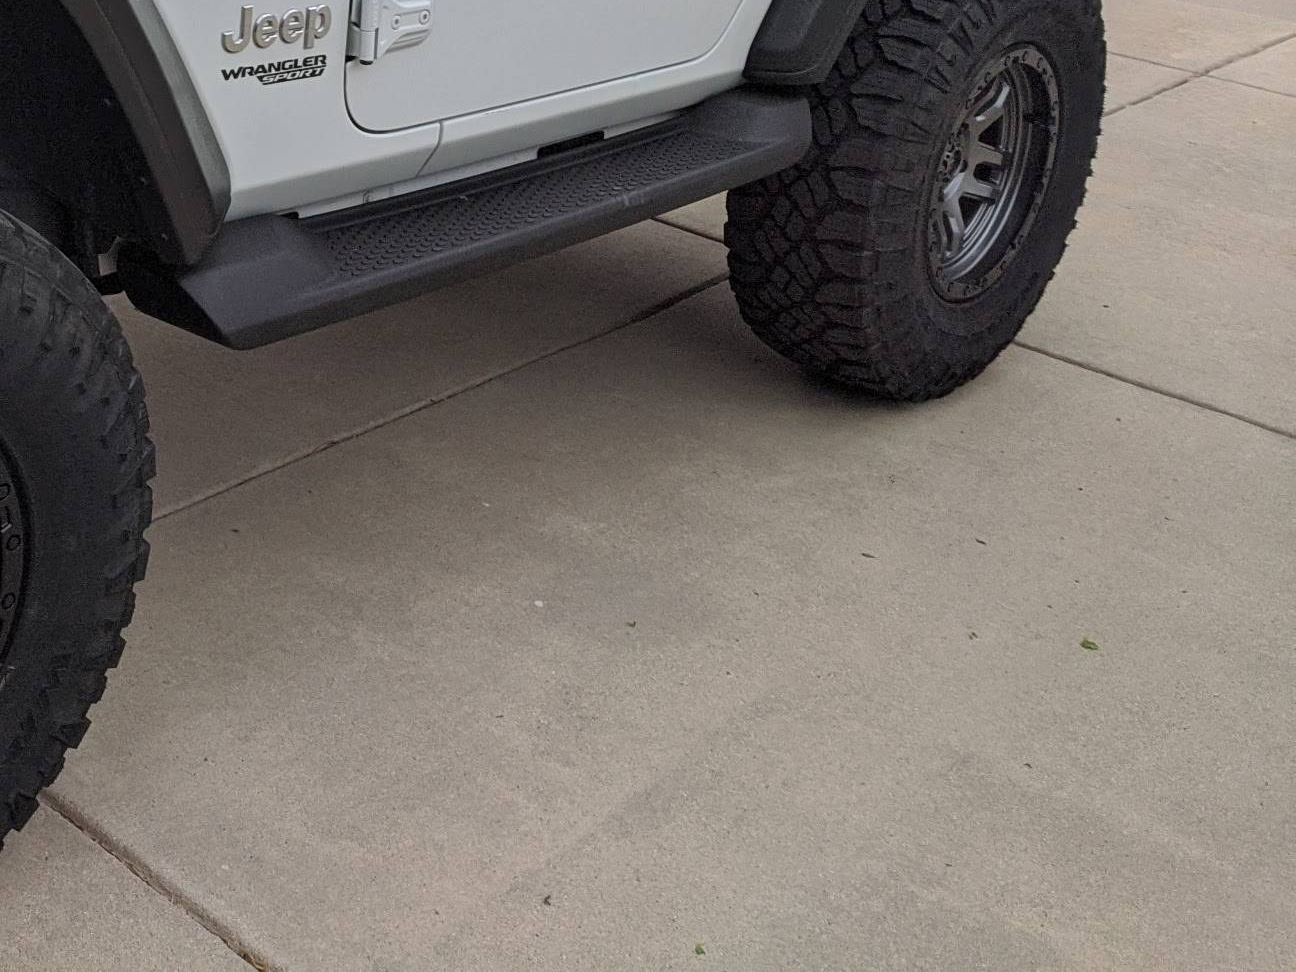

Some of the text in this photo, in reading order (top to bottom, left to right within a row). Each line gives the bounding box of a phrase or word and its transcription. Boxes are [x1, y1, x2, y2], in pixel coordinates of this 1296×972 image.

[221, 4, 332, 54] Jeep
[221, 54, 327, 81] WRANGLER
[257, 68, 325, 85] SPORT
